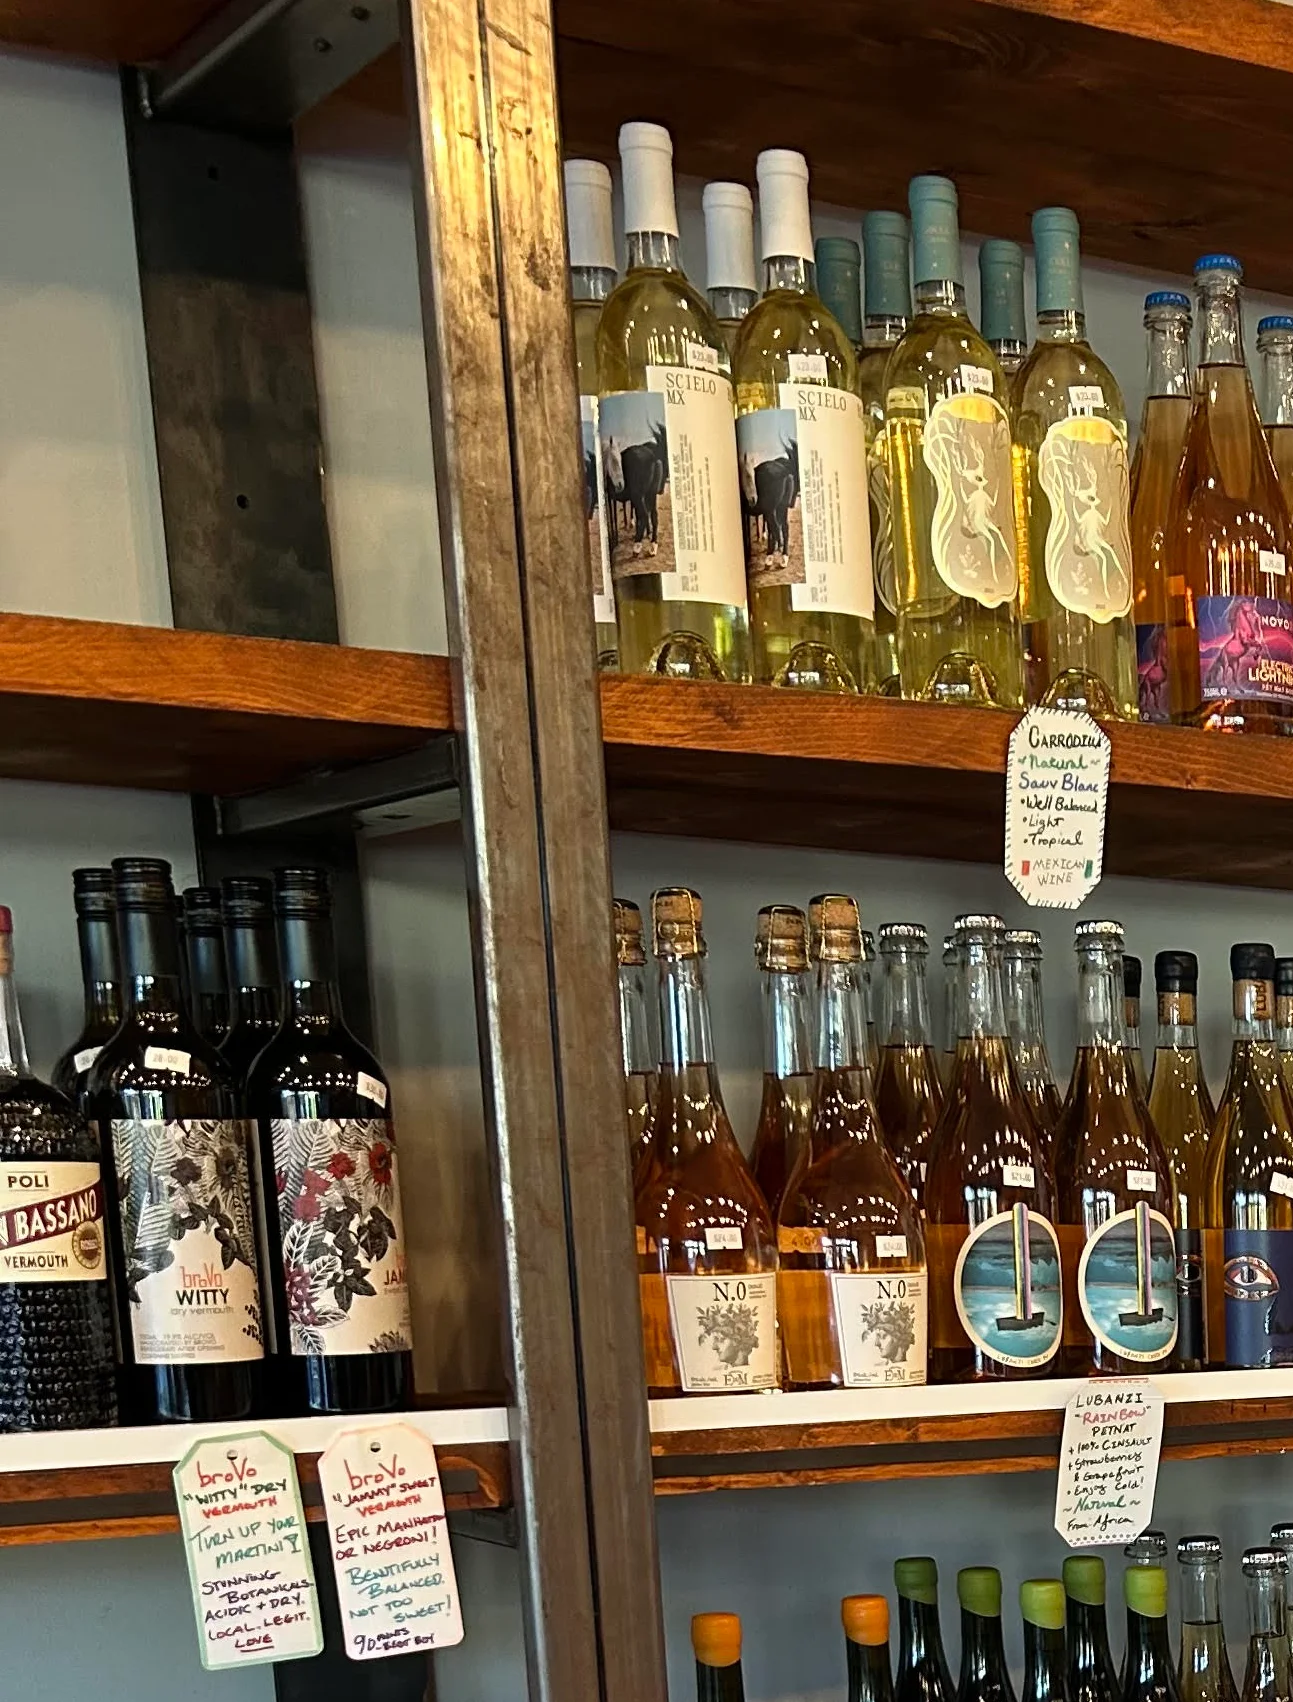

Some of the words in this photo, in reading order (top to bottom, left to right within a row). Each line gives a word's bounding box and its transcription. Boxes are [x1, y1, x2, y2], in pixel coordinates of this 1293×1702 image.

[666, 373, 717, 395] SCIELO
[667, 390, 686, 405] MX
[797, 391, 847, 412] SCIELO
[799, 406, 817, 422] MX
[1262, 615, 1289, 630] NOVO
[1029, 754, 1088, 769] Natural
[1019, 771, 1058, 789] Sauv
[1062, 773, 1099, 792] Blanc
[1029, 816, 1064, 833] Light
[1029, 832, 1083, 846] Tropical
[1033, 858, 1085, 870] MEXICAN
[1038, 872, 1073, 886] WINE
[7, 1175, 49, 1189] POLI
[16, 1188, 97, 1240] BASSANO
[4, 1254, 69, 1269] VERMOUTH
[176, 1288, 229, 1305] WITTY
[1076, 1392, 1144, 1408] LUBANZI
[1092, 1423, 1137, 1437] PETNAT
[251, 1479, 287, 1494] DRY
[1074, 1483, 1107, 1496] Enjoy
[202, 1496, 277, 1519] VERMOUTH
[188, 1526, 234, 1552] TURN
[240, 1522, 260, 1537] UP
[336, 1525, 370, 1544] EPIC
[216, 1542, 285, 1568] MARTINI
[335, 1546, 354, 1561] OR
[201, 1571, 280, 1596] STUNNING
[205, 1604, 250, 1623] ACIDIC
[349, 1606, 378, 1619] NOT
[384, 1597, 412, 1610] TOO
[235, 1634, 273, 1648] LOVE
